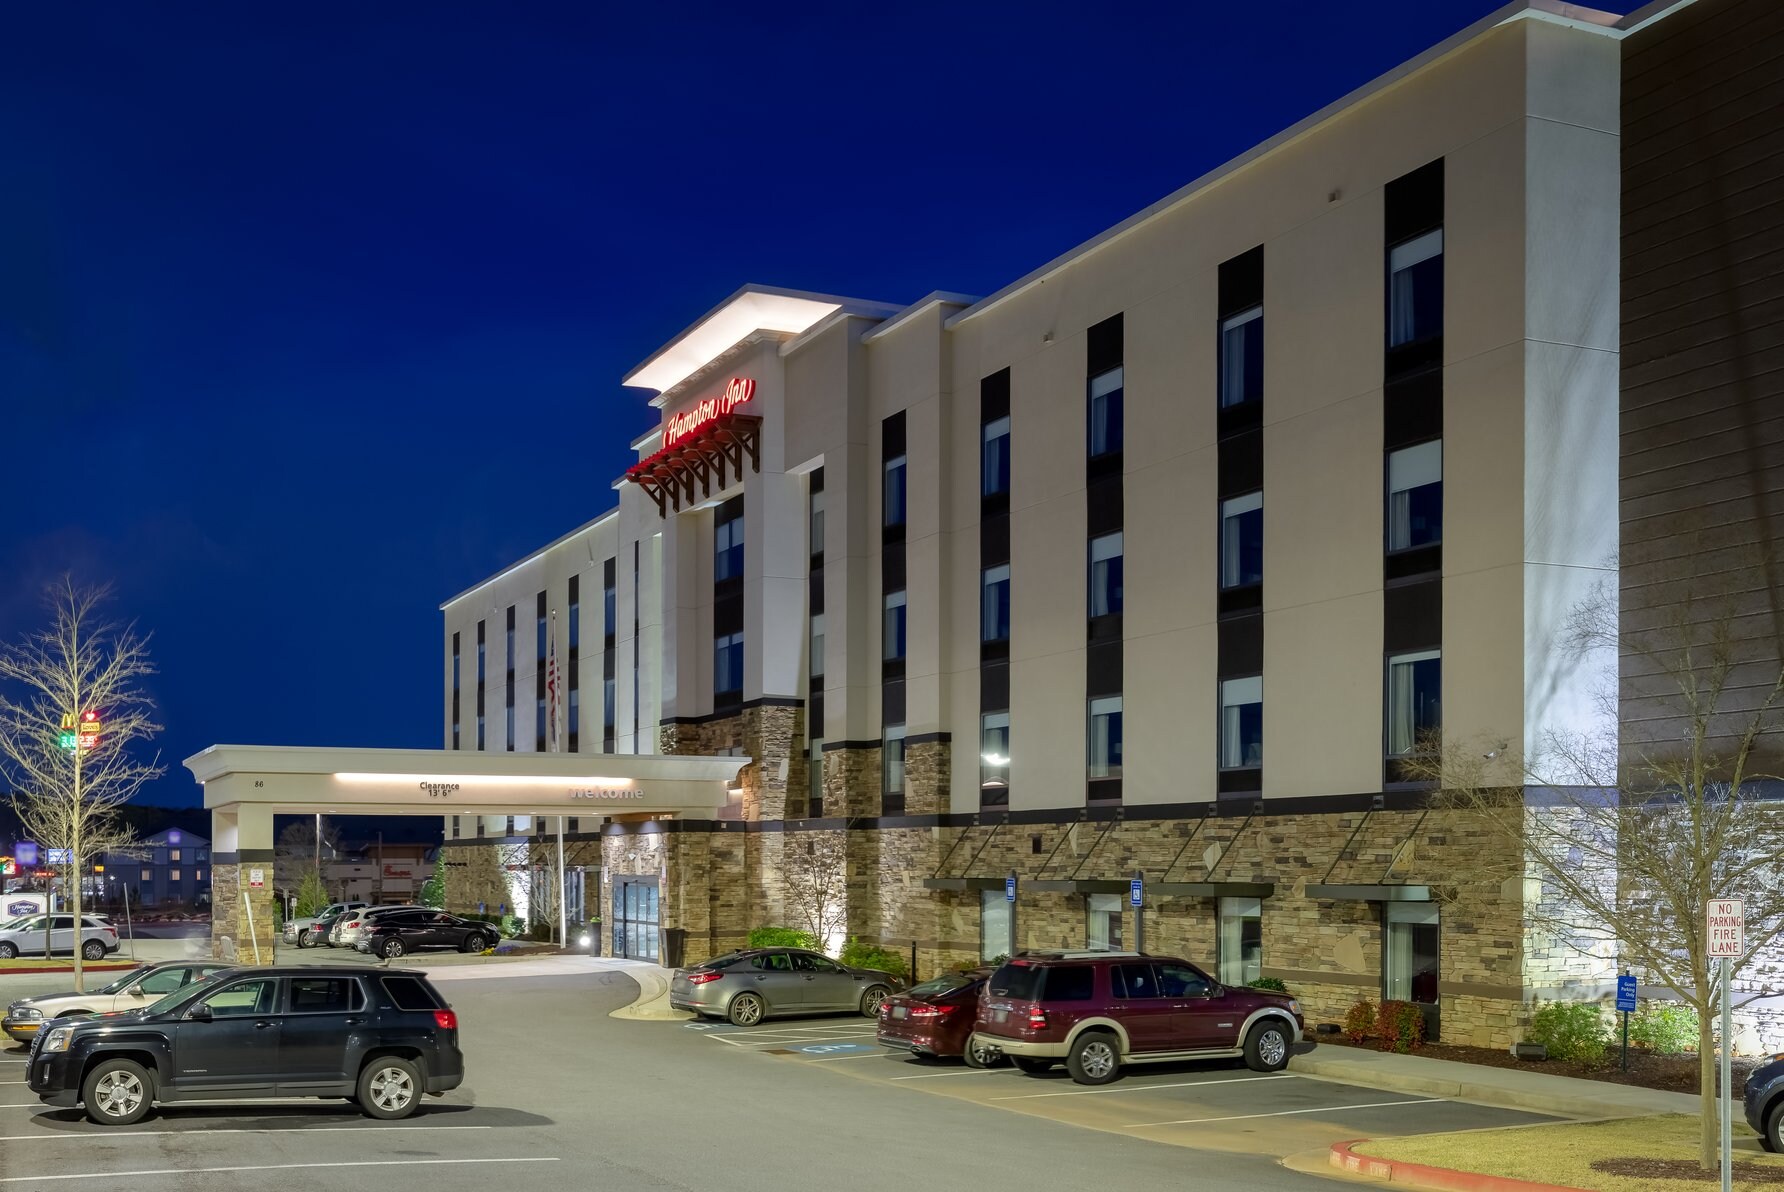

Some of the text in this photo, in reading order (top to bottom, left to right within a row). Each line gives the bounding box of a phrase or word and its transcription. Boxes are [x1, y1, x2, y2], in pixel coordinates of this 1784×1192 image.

[662, 378, 754, 448] Hampton Inn
[254, 780, 264, 788] 86
[419, 781, 460, 790] Clearance
[428, 789, 452, 797] 13' 6"
[568, 786, 644, 799] welcome
[1718, 903, 1732, 915] NO
[1709, 916, 1741, 927] PARKING
[1713, 929, 1737, 940] FIRE
[1711, 941, 1739, 953] LANE
